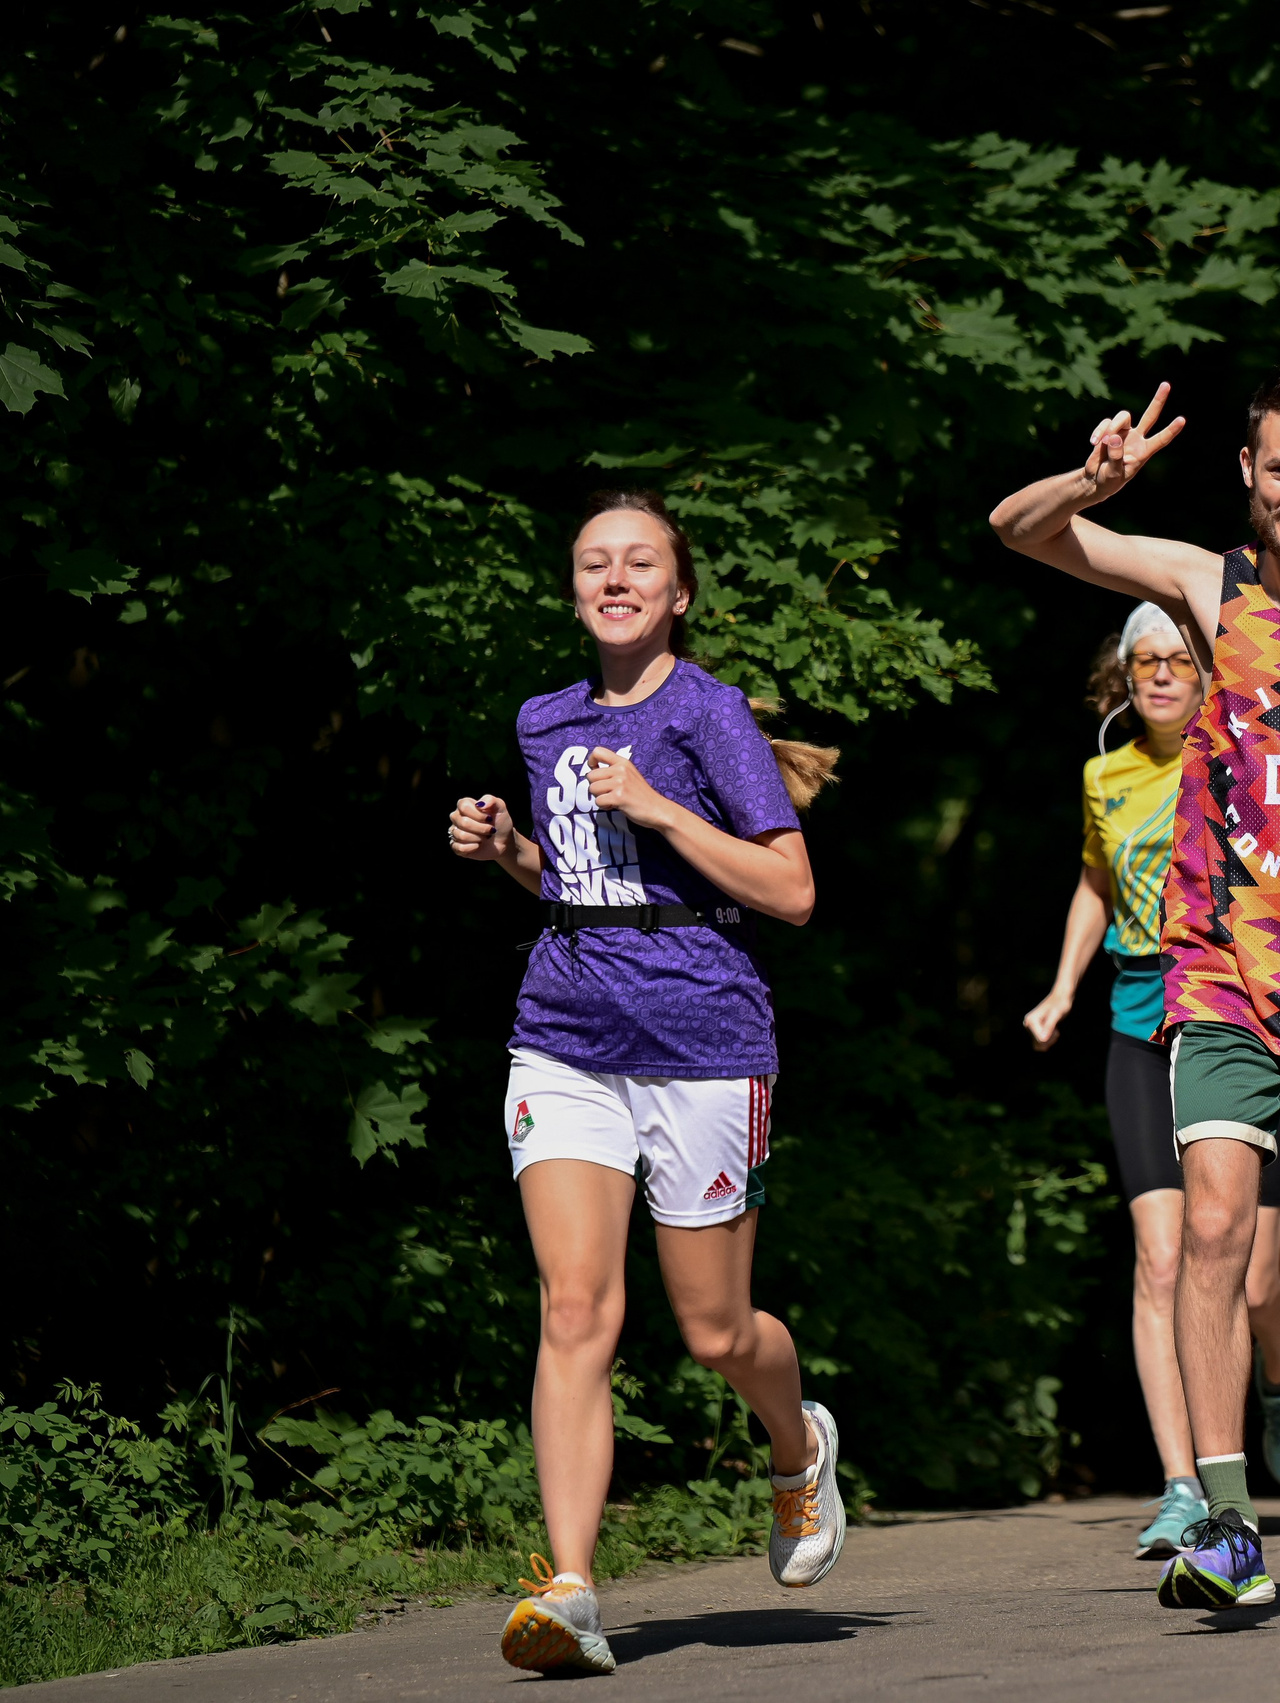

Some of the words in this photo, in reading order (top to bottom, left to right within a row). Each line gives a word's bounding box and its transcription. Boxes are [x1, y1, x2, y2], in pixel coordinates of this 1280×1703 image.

[548, 812, 639, 873] 9AM
[715, 907, 741, 924] 9:00
[703, 1185, 737, 1200] adidas
